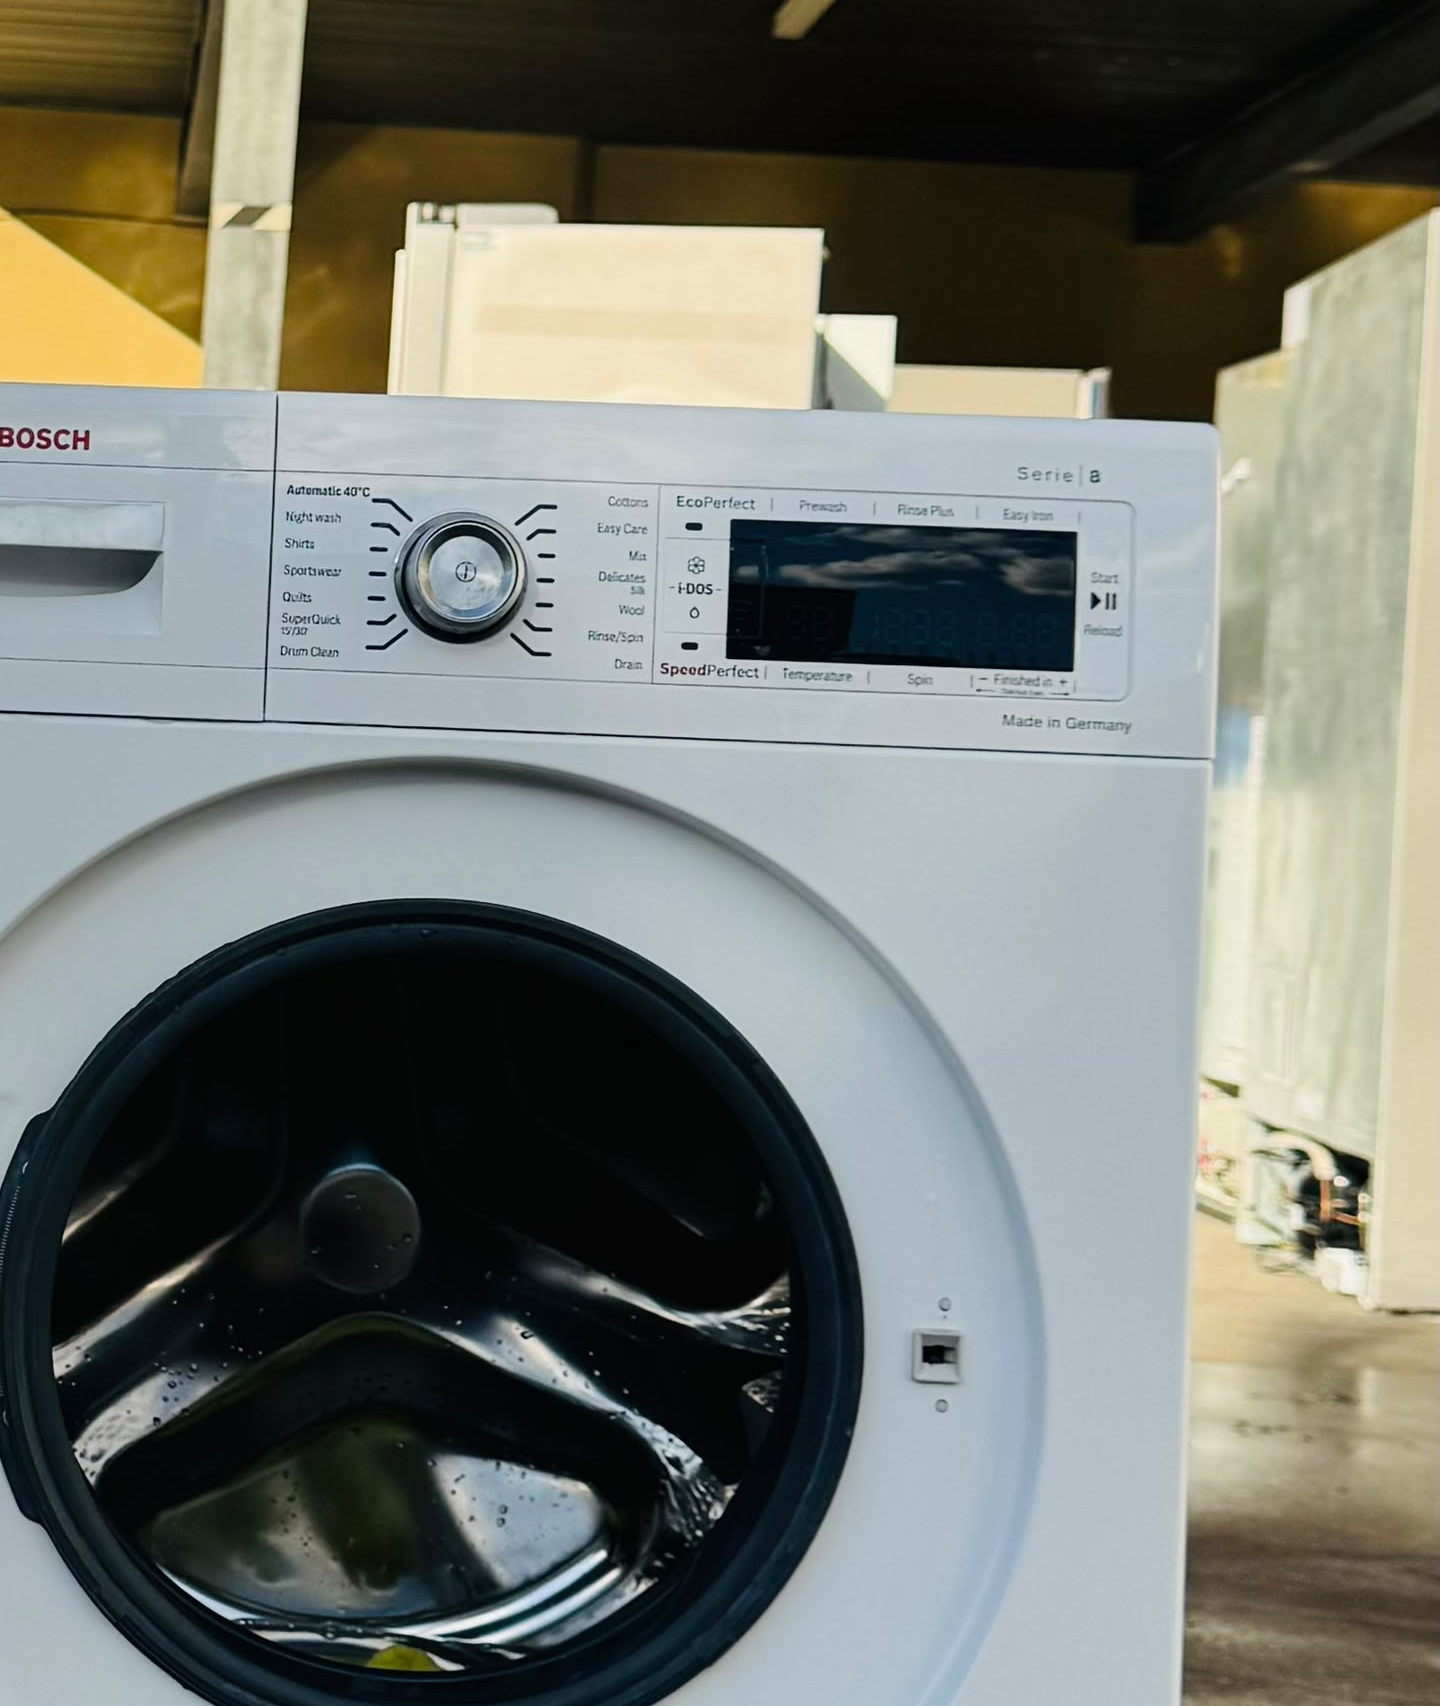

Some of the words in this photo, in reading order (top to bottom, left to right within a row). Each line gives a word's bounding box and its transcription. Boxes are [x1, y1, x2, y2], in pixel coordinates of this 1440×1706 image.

[1017, 466, 1073, 483] Serie
[286, 484, 342, 496] Automatic
[676, 495, 756, 511] EcoPerfect
[284, 537, 315, 549] Shirts
[280, 645, 309, 656] Drum
[659, 661, 760, 679] SpeedPerfect
[906, 672, 934, 687] Spin
[1002, 714, 1043, 728] Made
[1047, 715, 1061, 728] in
[1065, 717, 1133, 735] Germany
